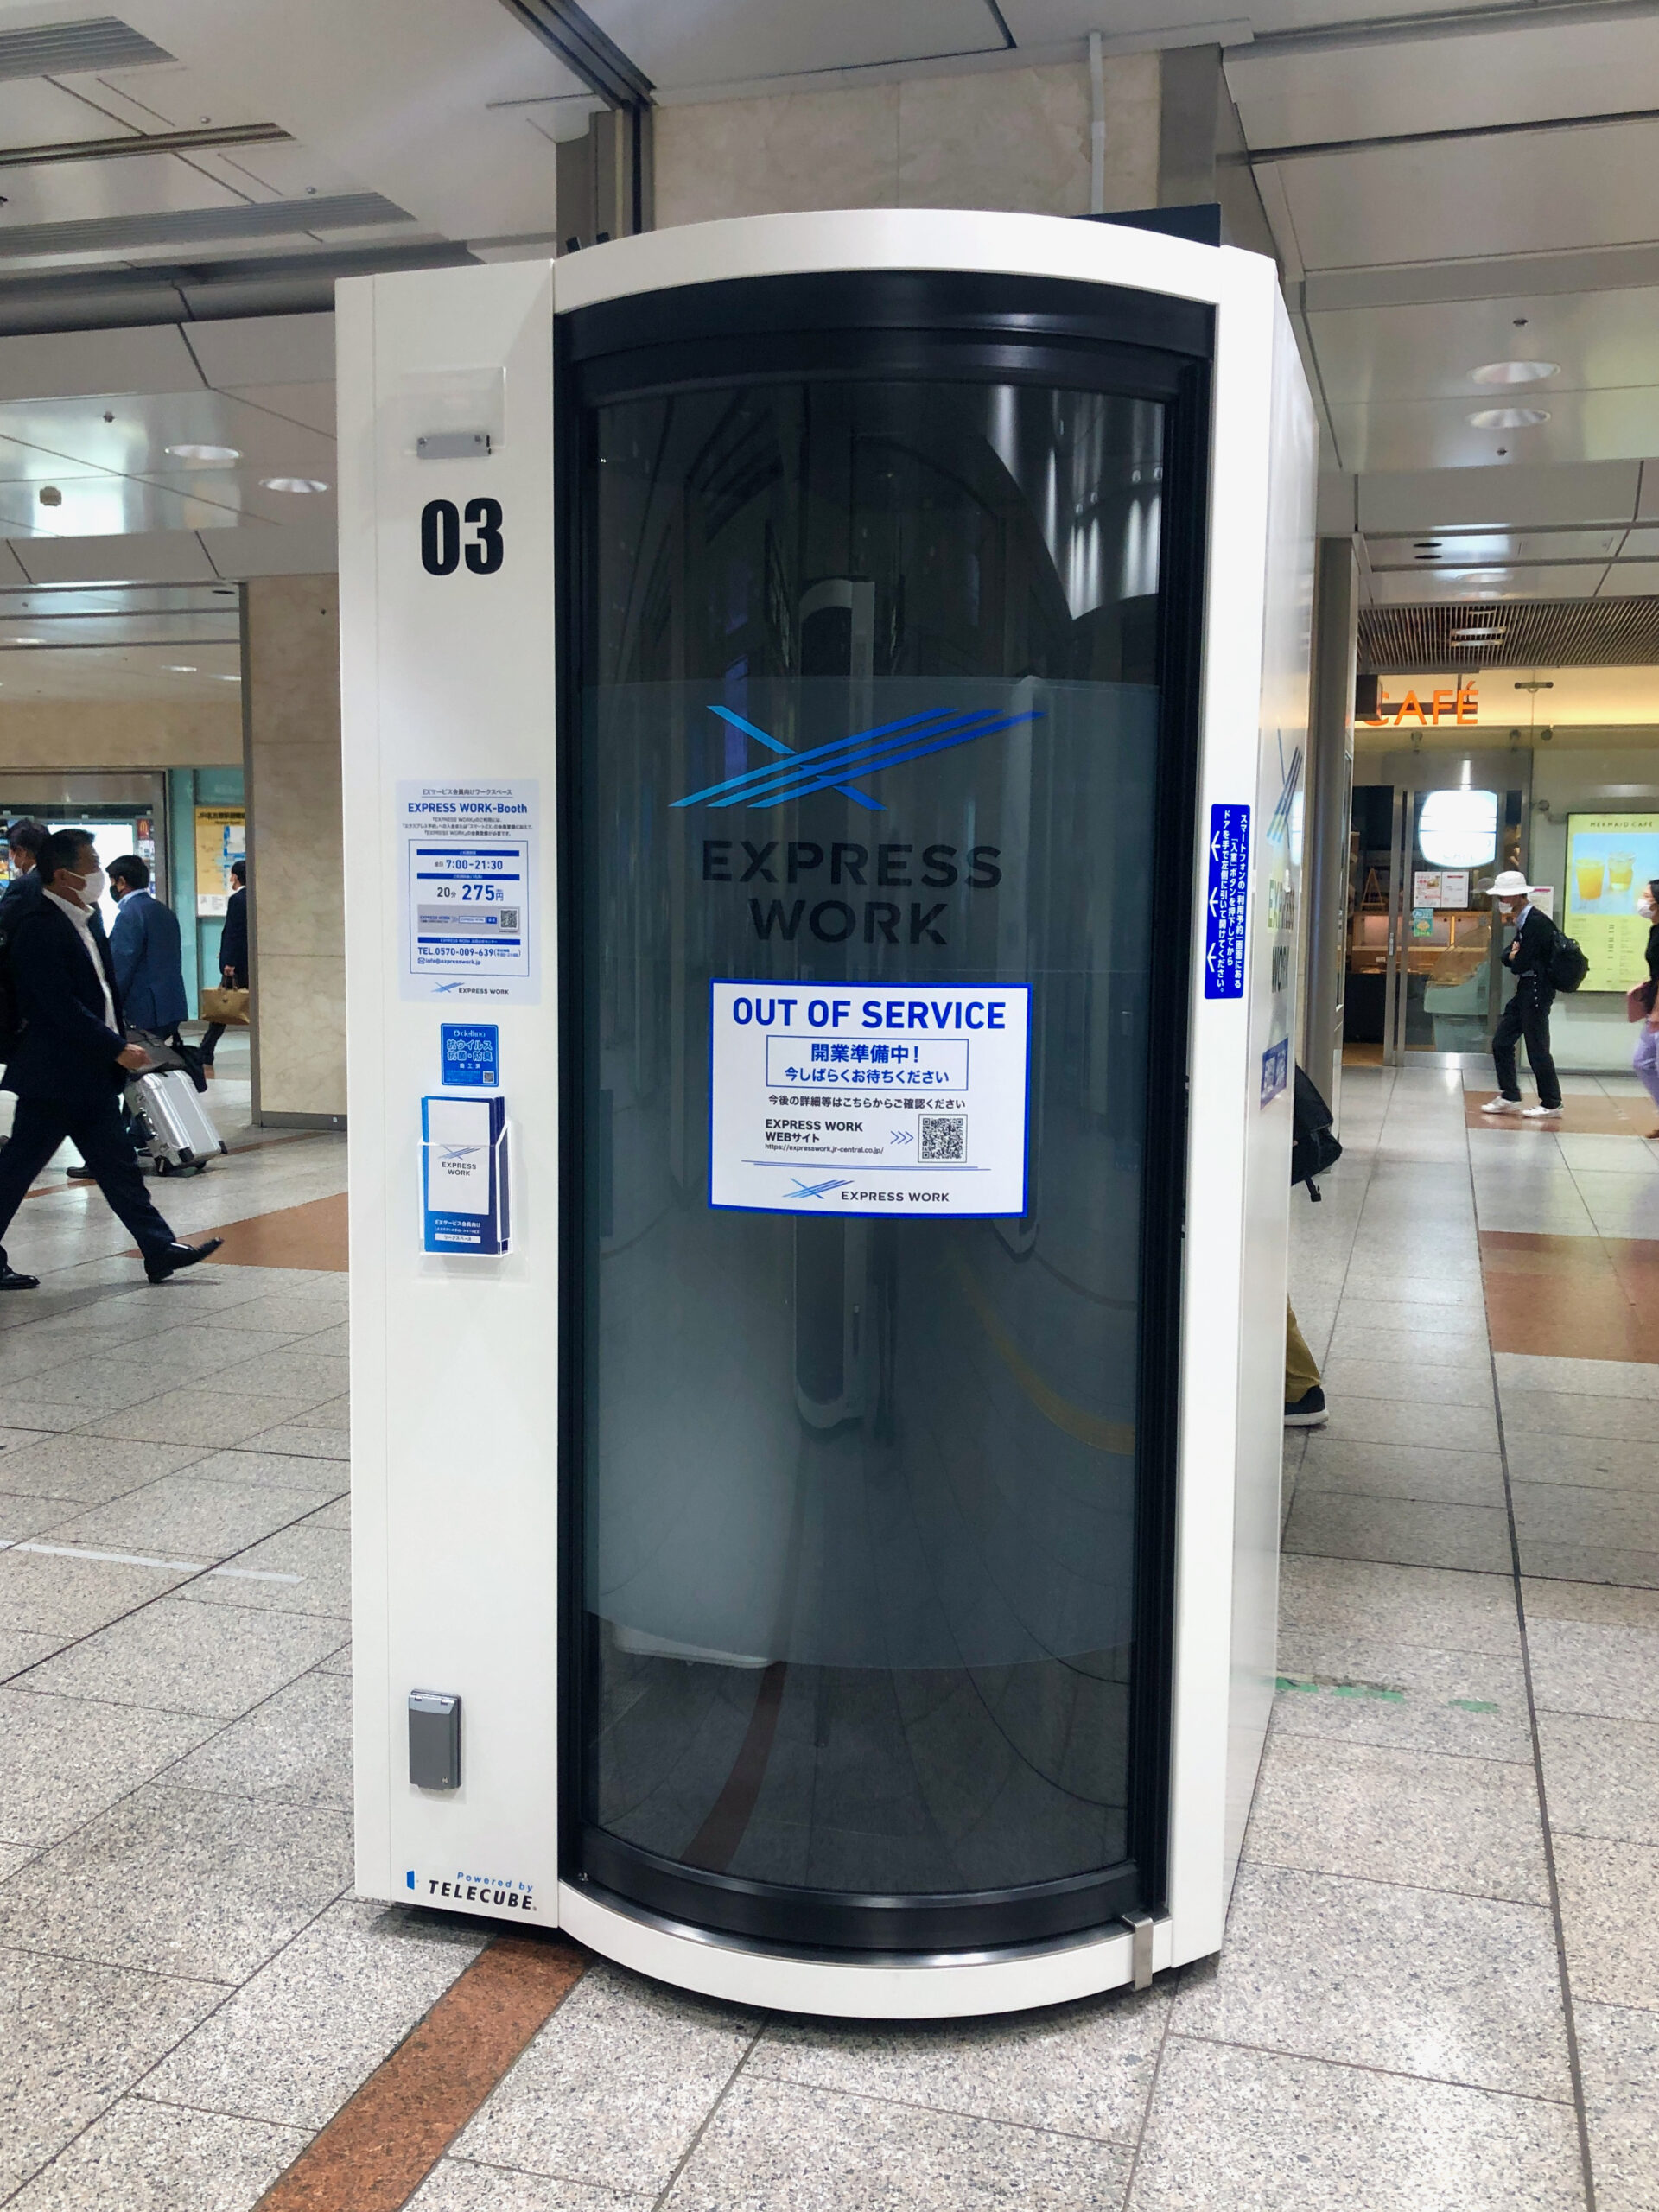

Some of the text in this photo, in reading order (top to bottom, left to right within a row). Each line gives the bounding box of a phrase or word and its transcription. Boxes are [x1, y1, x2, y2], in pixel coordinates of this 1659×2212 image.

[421, 497, 504, 576] 03
[408, 802, 528, 814] EXPRESS WORK-Booth
[446, 860, 503, 869] 7:00-21:30
[702, 840, 1002, 889] EXPRESS
[436, 884, 504, 901] 20分 275円
[748, 898, 948, 945] WORK
[733, 997, 1007, 1030] OUT OF SERVICE
[447, 1039, 493, 1051] 抗ウイルス
[447, 1050, 493, 1062] 抗菌・防臭
[785, 1066, 950, 1084] 今しばらくお待ちください
[768, 1095, 966, 1109] 今後の詳細等はこちらからご確認ください
[766, 1118, 863, 1132] EXPRESS WORK
[766, 1131, 820, 1143] WEBサイト
[765, 1143, 884, 1154] https://expresswork.jr-central.co.jp/
[442, 1161, 477, 1170] EXPRESS
[841, 1191, 950, 1202] EXPRESS WORK
[457, 1872, 534, 1894] Powered by
[429, 1879, 532, 1910] TELECUBE
